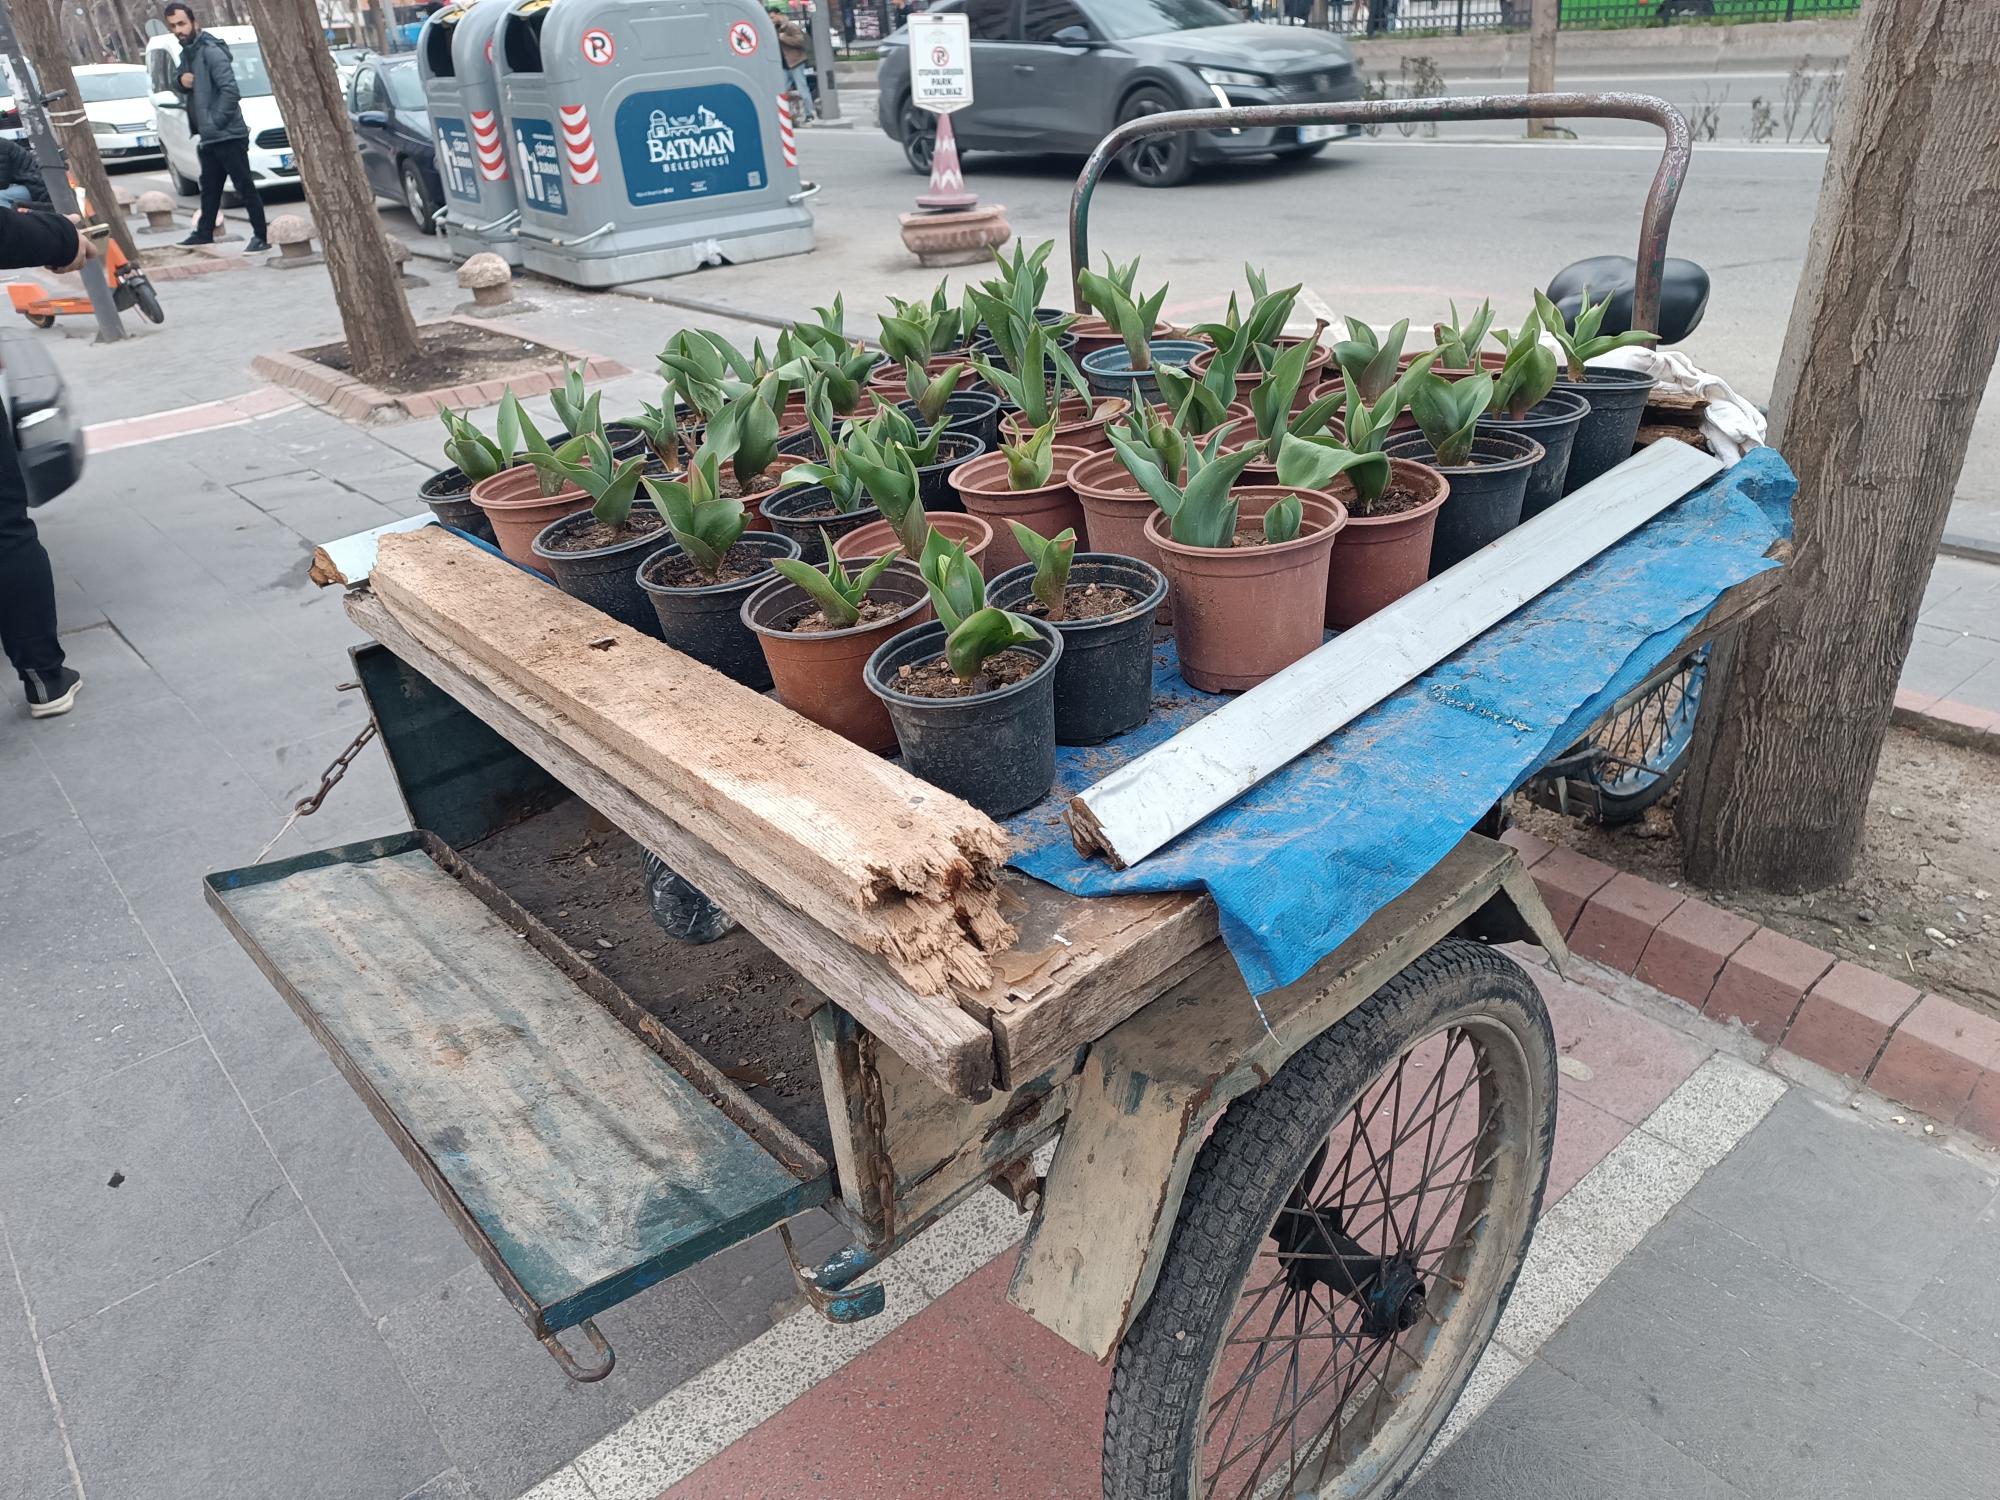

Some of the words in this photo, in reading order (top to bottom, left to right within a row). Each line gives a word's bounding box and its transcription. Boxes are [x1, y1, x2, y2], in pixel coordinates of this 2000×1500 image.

[931, 77, 953, 86] PARK
[922, 87, 964, 96] YAPILMAZ
[646, 129, 736, 163] BATMAN
[662, 154, 730, 173] BELEDİYESİ
